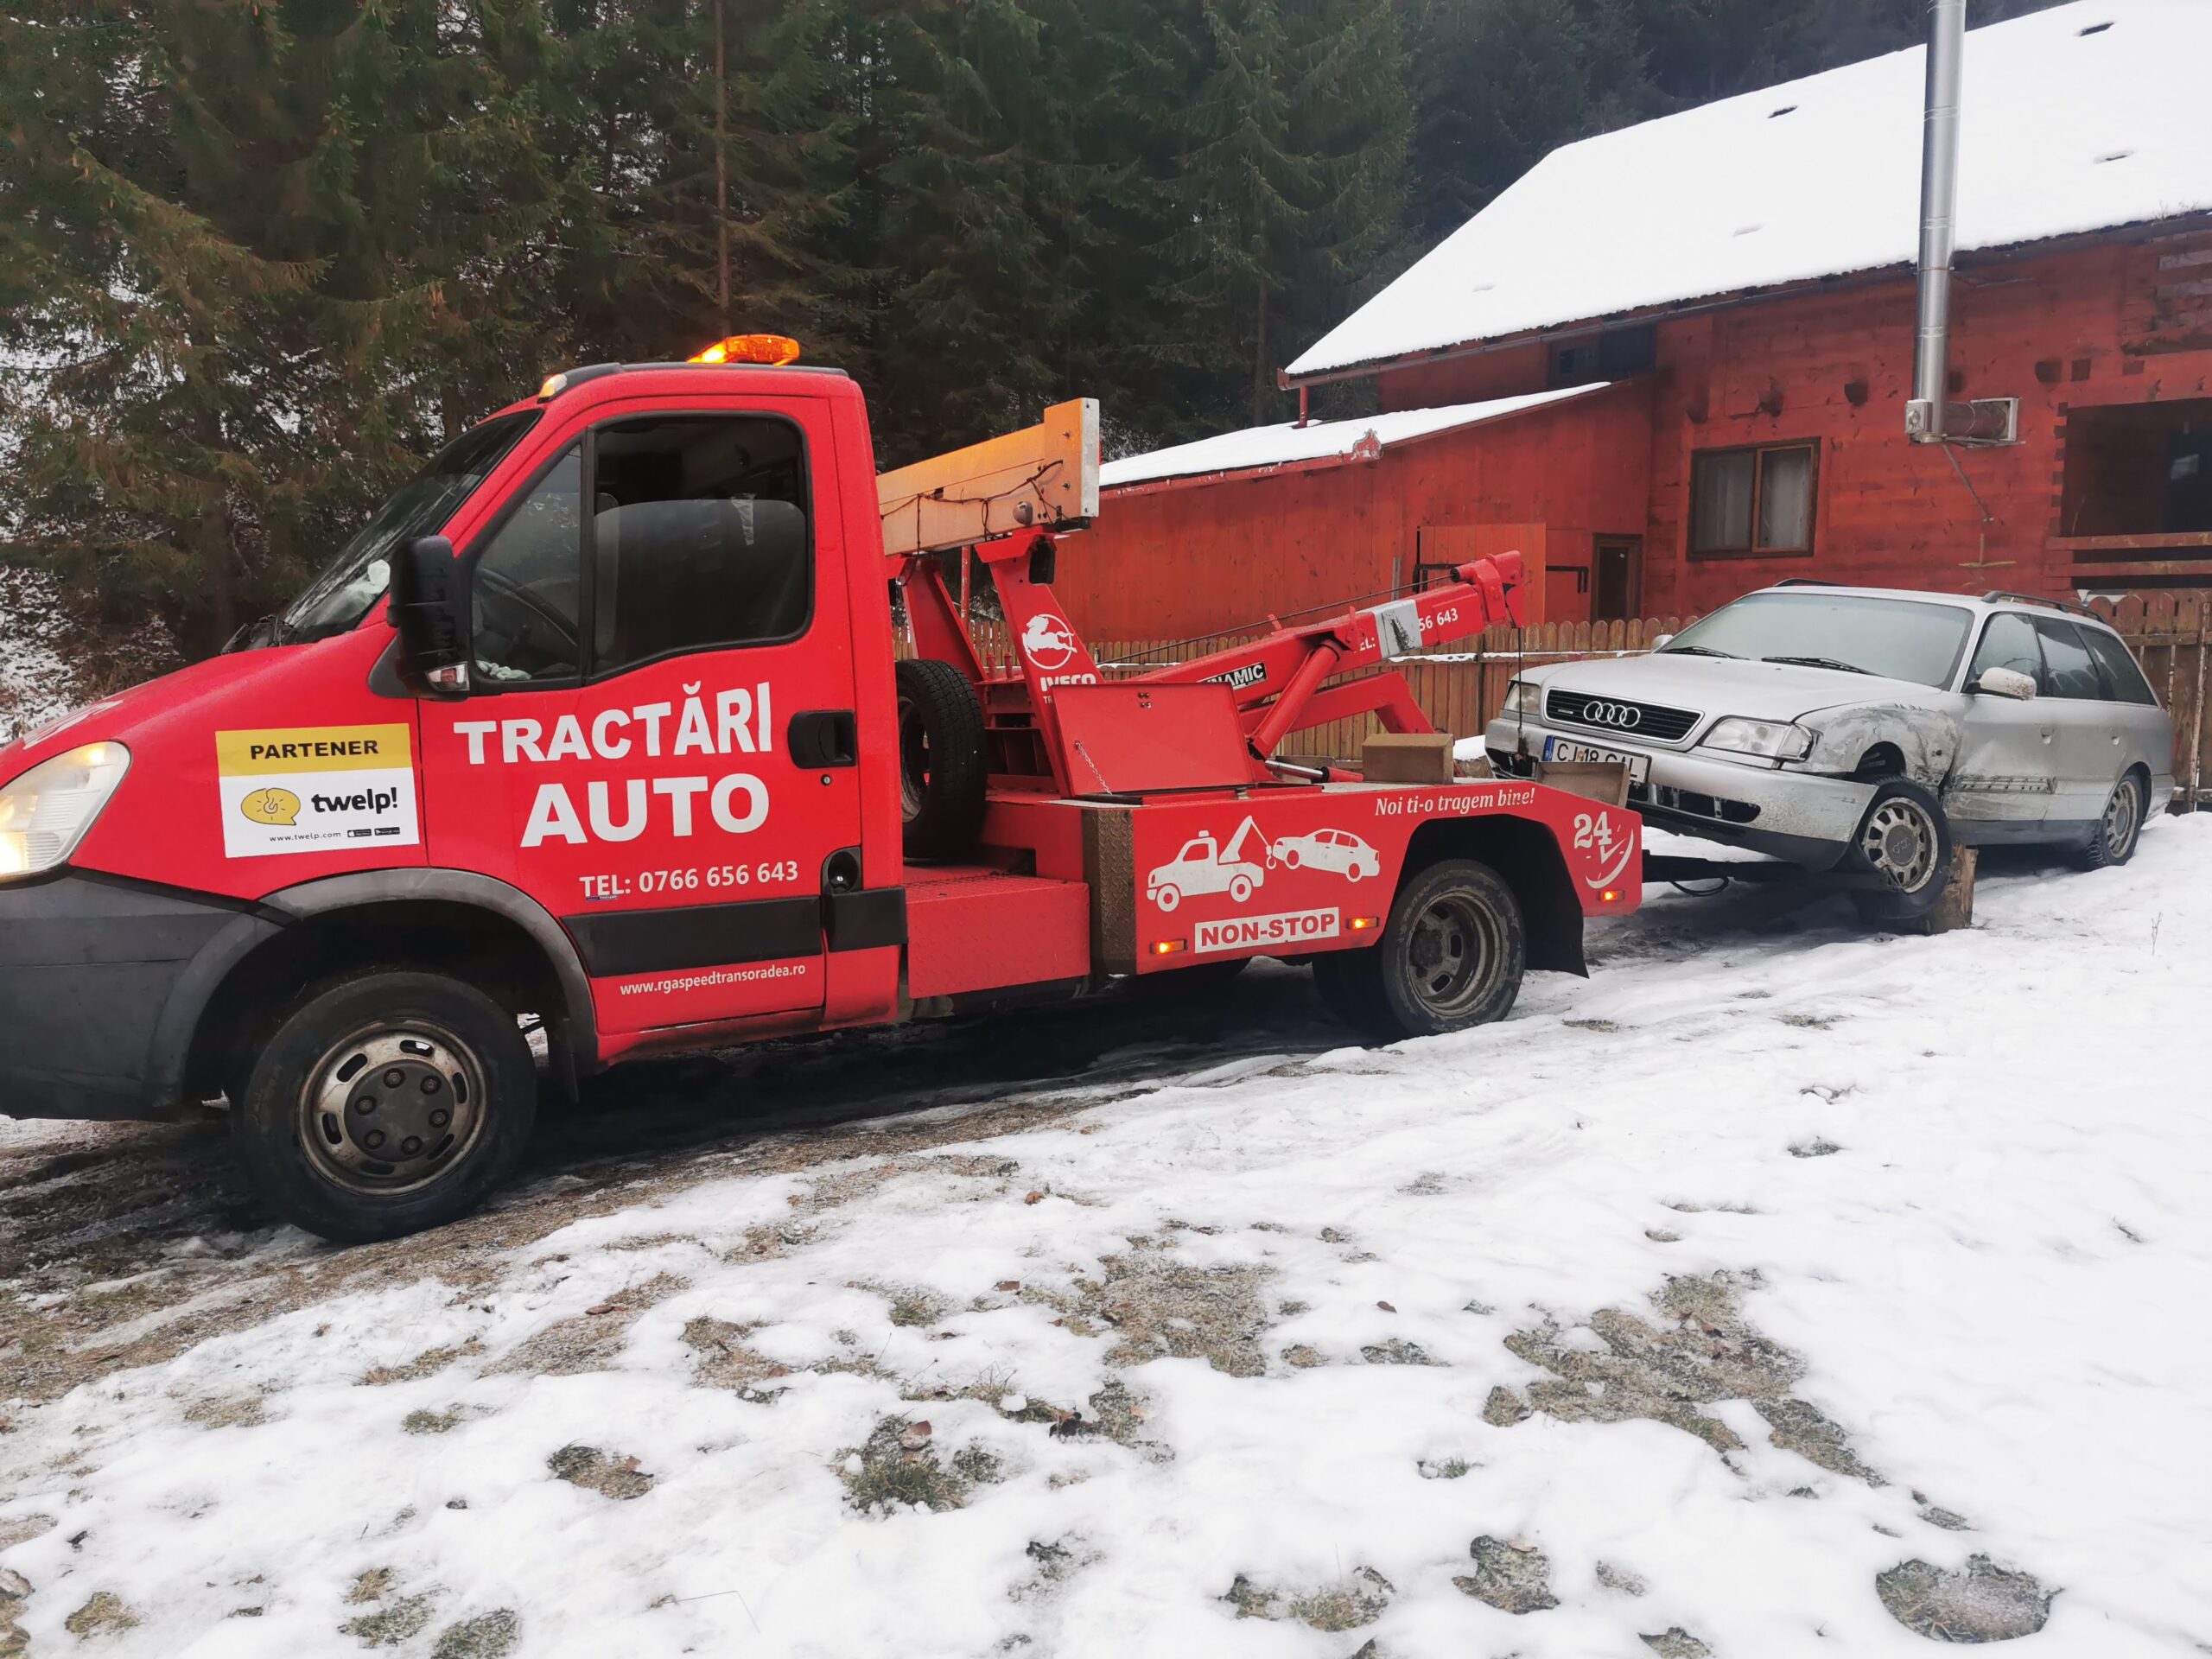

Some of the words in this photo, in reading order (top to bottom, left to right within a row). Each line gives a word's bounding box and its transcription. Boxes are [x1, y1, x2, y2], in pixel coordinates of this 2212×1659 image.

[1358, 636, 1376, 652] EL:
[1419, 615, 1433, 632] 56
[1436, 607, 1459, 626] 643
[453, 680, 772, 765] TRACTĂRI
[250, 740, 379, 760] PARTENER
[310, 786, 398, 815] twelp!
[519, 772, 770, 848] AUTO
[1375, 797, 1403, 816] Noi
[1406, 798, 1434, 814] ti-o
[1437, 792, 1495, 815] tragem
[1497, 787, 1536, 807] bine!
[269, 830, 342, 843] www.twelp.com
[1573, 810, 1612, 849] 24
[579, 874, 632, 897] TEL:
[639, 868, 699, 893] 0766
[706, 864, 750, 887] 656
[756, 861, 799, 883] 643
[1201, 913, 1336, 947] NON-STOP
[620, 963, 806, 995] www.rgaspeedtransoradea.ro
